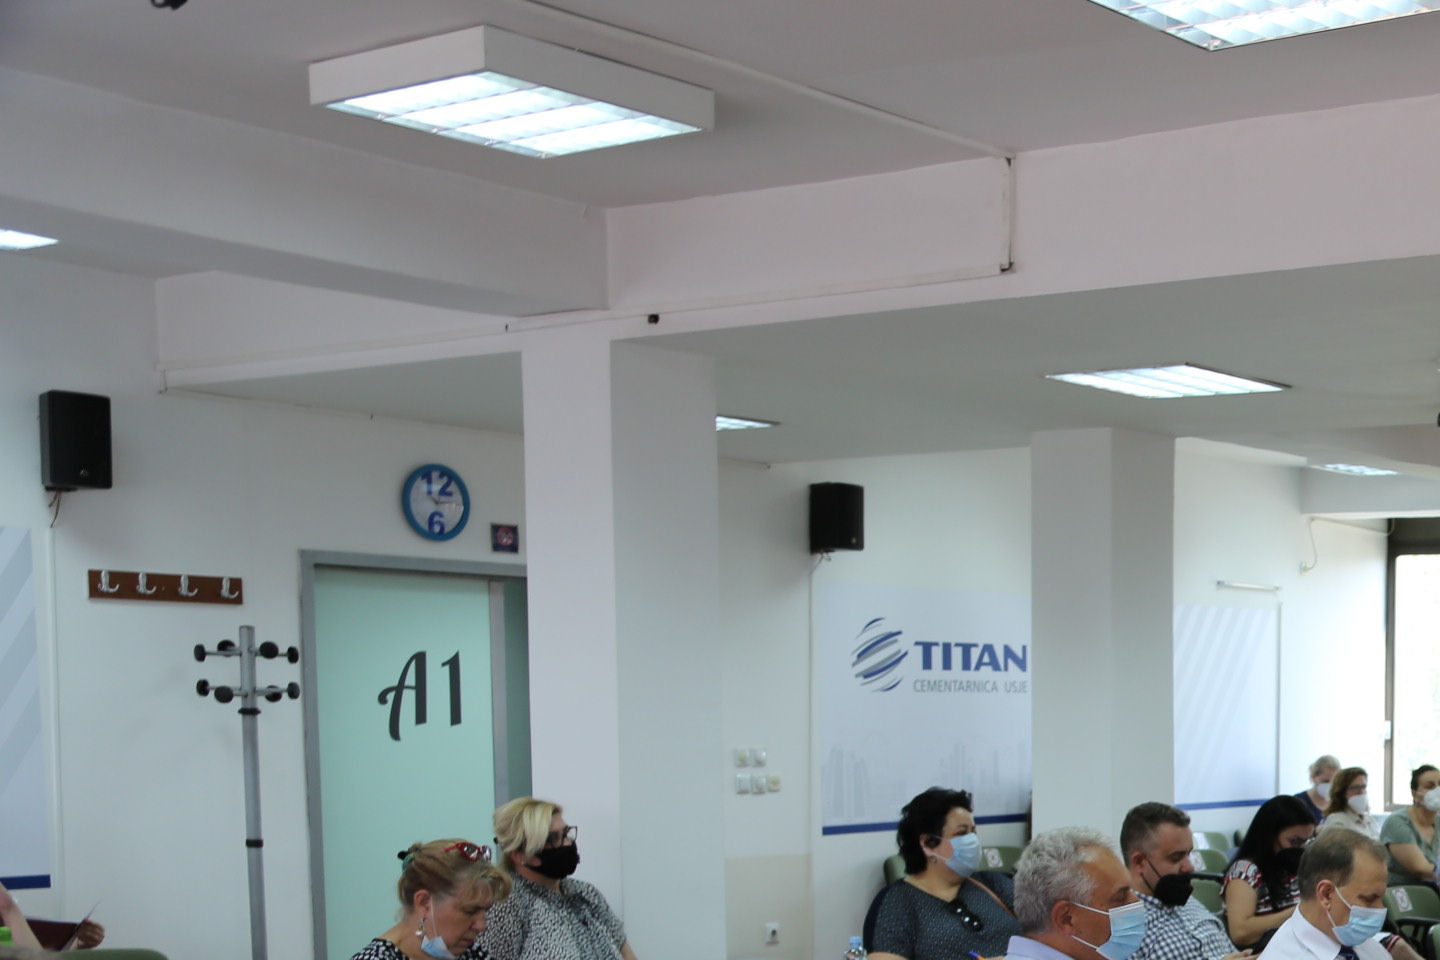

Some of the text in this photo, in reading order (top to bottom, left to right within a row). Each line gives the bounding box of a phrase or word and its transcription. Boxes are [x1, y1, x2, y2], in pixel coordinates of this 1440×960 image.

[421, 471, 454, 497] 12
[428, 511, 446, 536] 6
[914, 641, 1027, 672] TITAN
[378, 650, 462, 742] A1
[913, 679, 1028, 694] CEMENTARNICA USJE
